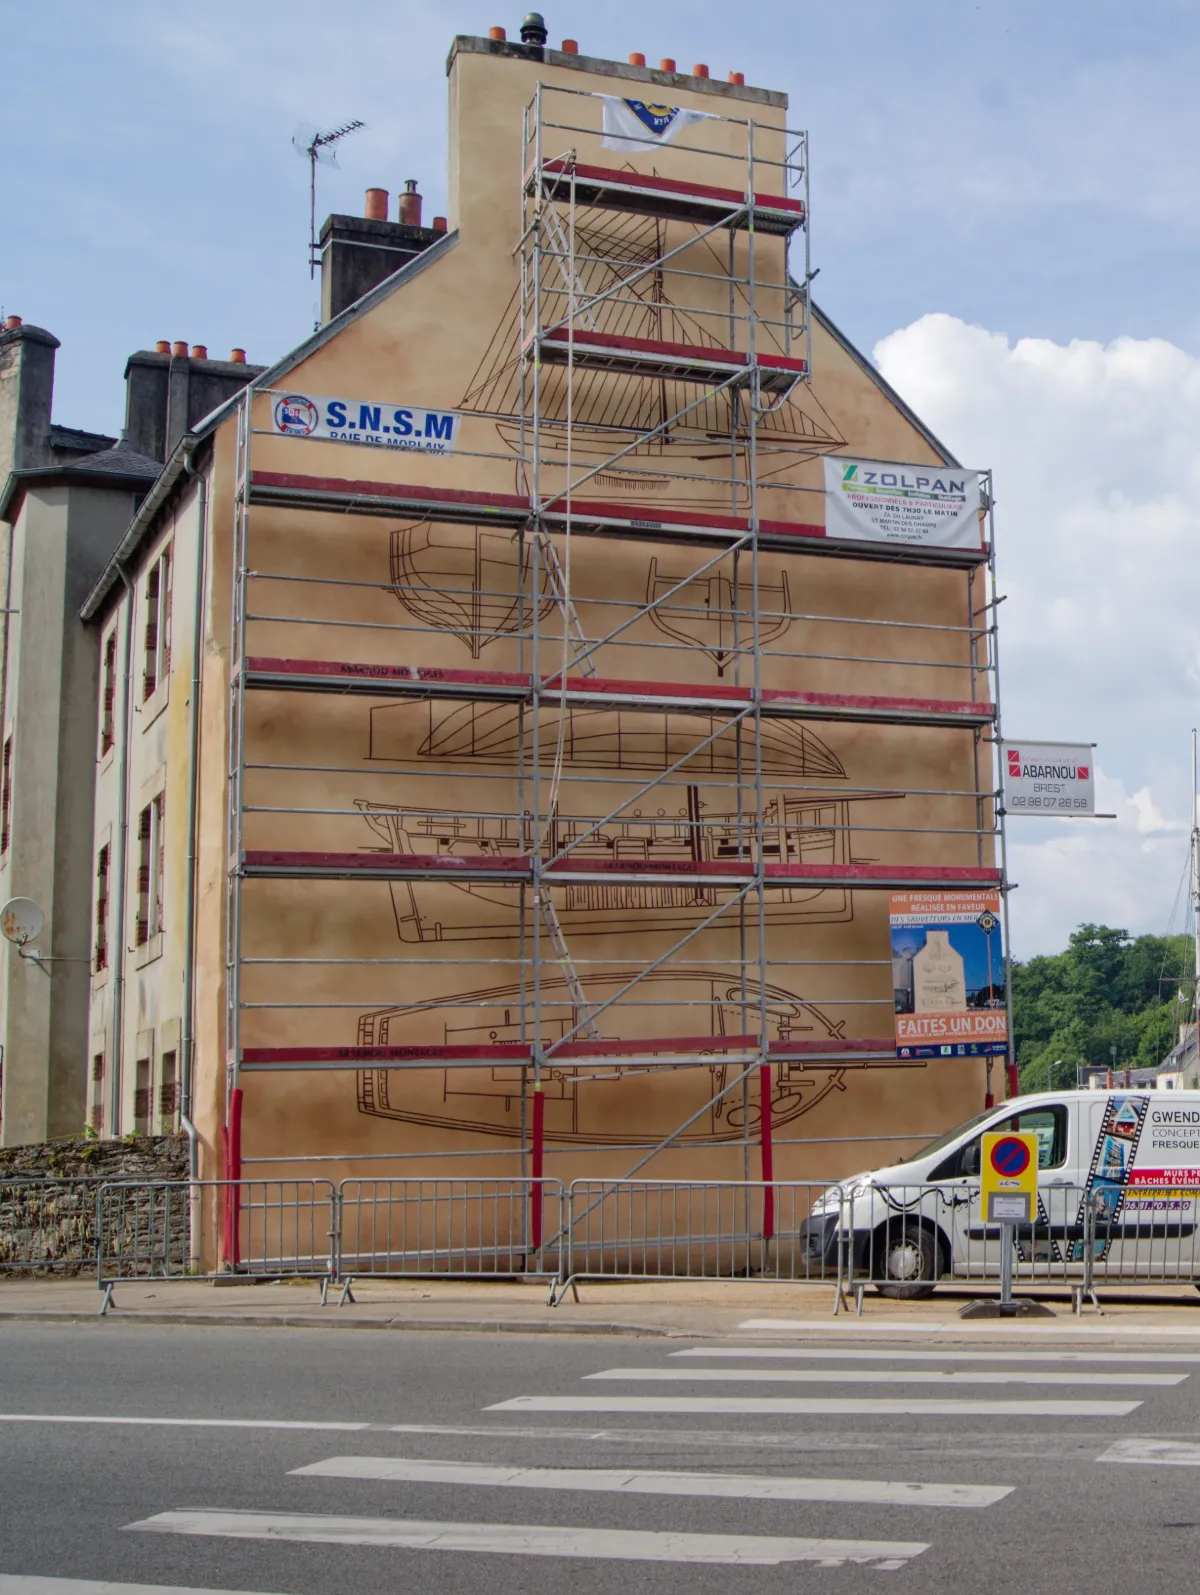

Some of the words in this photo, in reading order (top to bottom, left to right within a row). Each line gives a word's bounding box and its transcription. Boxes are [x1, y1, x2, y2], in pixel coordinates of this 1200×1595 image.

[326, 401, 454, 440] S.N.S.M
[863, 472, 965, 494] ZOLPAN
[852, 502, 884, 511] OUVERT
[902, 506, 922, 514] 7H30
[934, 509, 958, 517] MATIN
[914, 521, 937, 529] CHAMPS
[1022, 764, 1076, 780] ABARNOU
[1033, 783, 1066, 793] BREST
[1012, 796, 1026, 806] 02
[1028, 797, 1042, 807] 98
[1043, 797, 1057, 807] 07
[1058, 798, 1072, 808] 26
[1073, 798, 1087, 808] 59
[891, 894, 908, 902] UNE
[909, 893, 942, 902] FRESQUE
[943, 893, 998, 902] MONUMENTALE
[910, 902, 945, 912] RÉALISÉE
[946, 903, 957, 911] EN
[957, 903, 986, 911] FAVEUR
[906, 915, 951, 923] SAUVETEURS
[897, 1019, 947, 1035] FAITES
[950, 1018, 972, 1033] UN
[975, 1016, 1006, 1031] DON
[1163, 1169, 1189, 1177] MURS
[1134, 1175, 1169, 1185] BÂCHES
